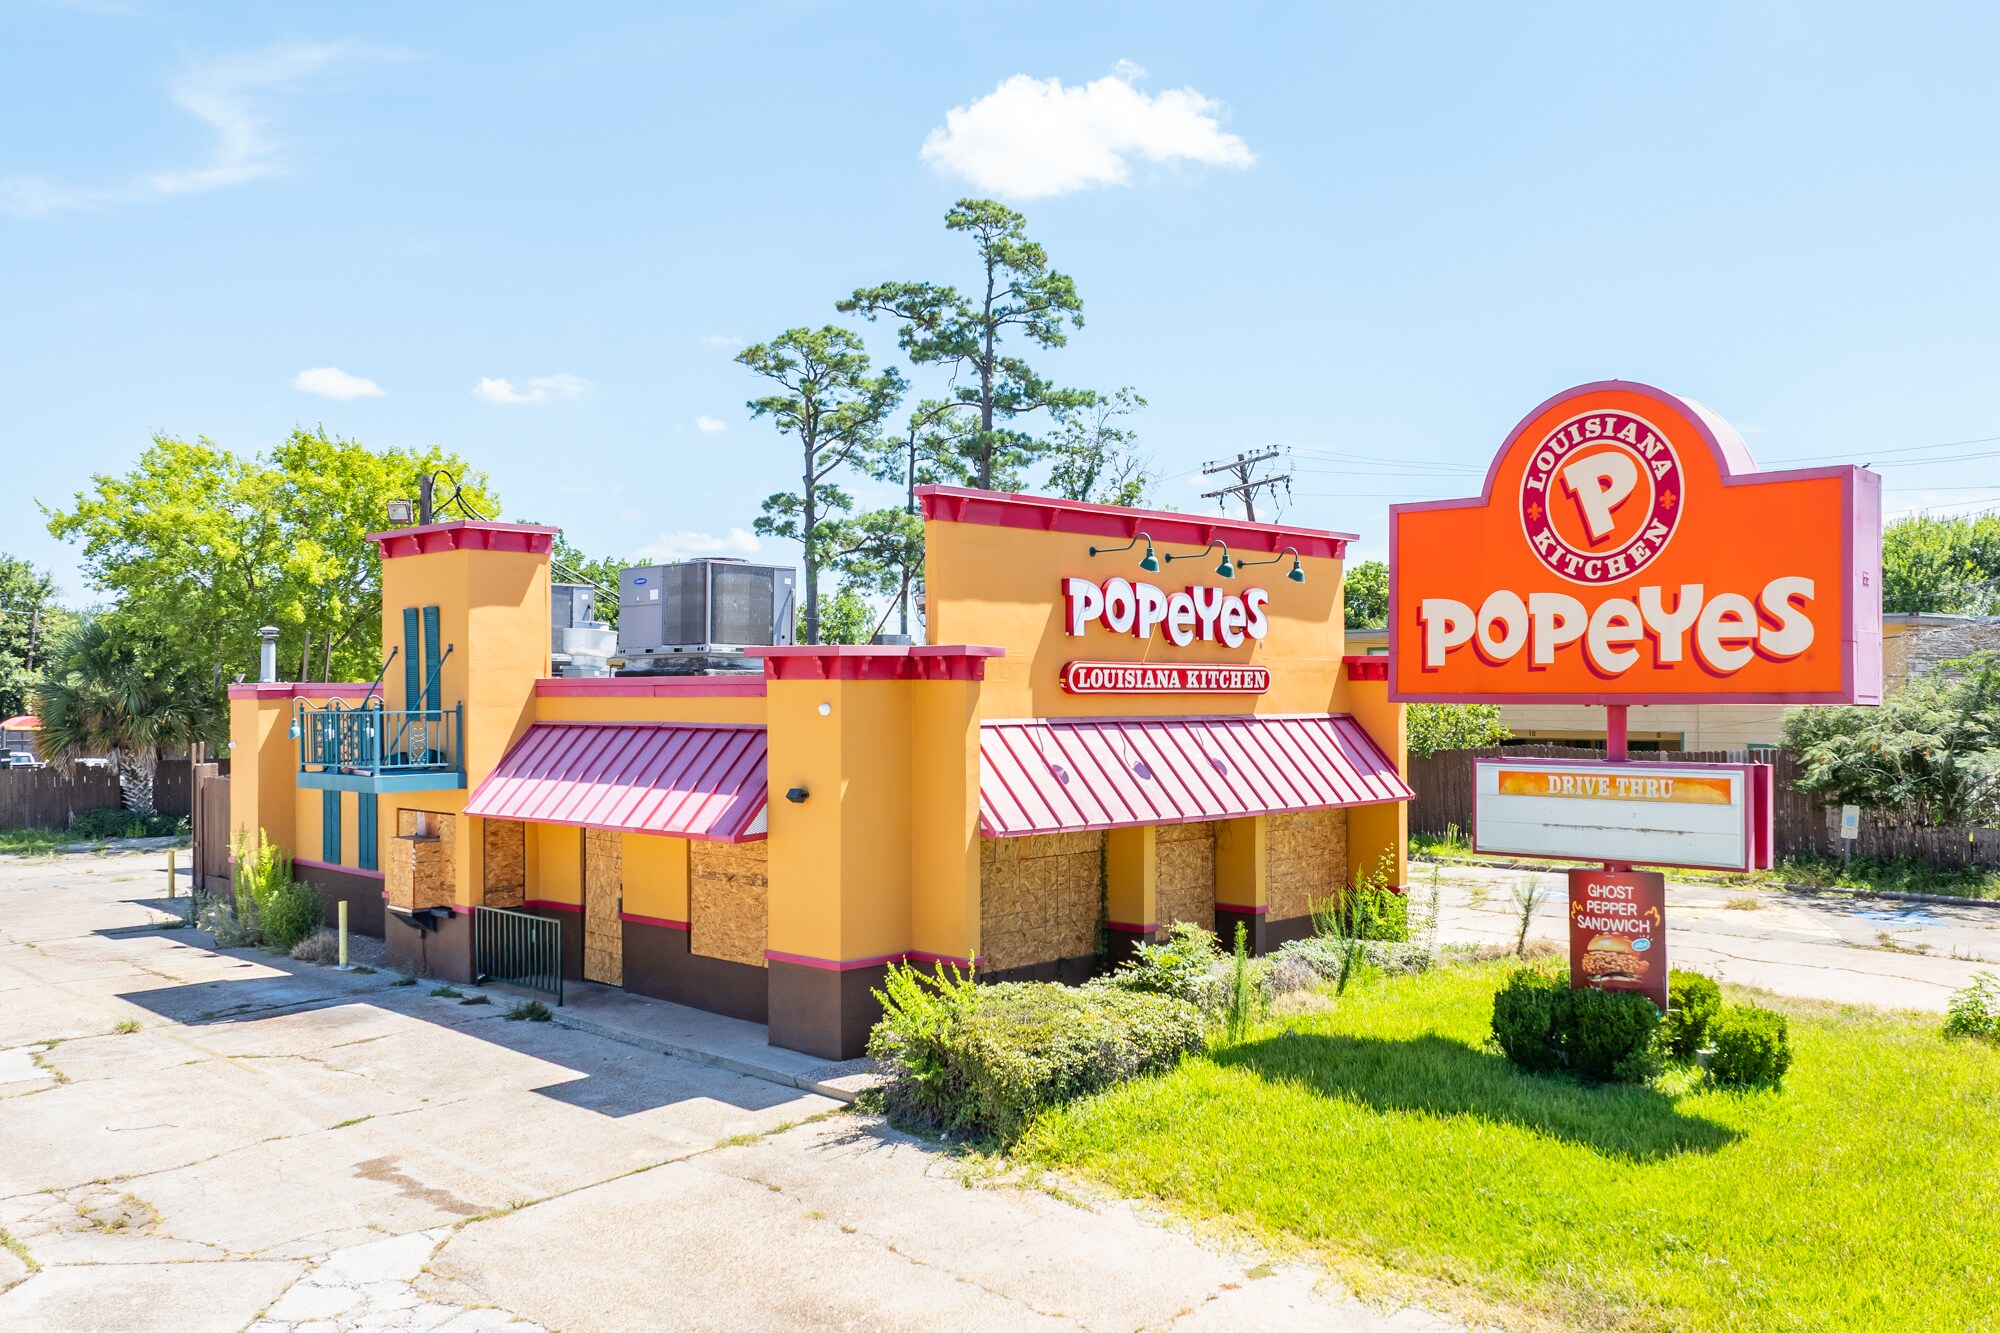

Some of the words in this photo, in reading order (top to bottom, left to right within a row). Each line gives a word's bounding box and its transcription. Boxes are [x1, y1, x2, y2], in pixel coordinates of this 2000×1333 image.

[1527, 417, 1673, 492] LOUISIANA
[1561, 451, 1638, 542] P
[1532, 518, 1669, 579] KITCHEN
[1077, 669, 1181, 689] LOUISIANA
[1186, 670, 1266, 689] KITCHEN
[1547, 775, 1609, 796] DRIVE
[1616, 777, 1673, 798] THRU
[1587, 883, 1634, 899] GHOST
[1586, 900, 1637, 916] PEPPER
[1577, 914, 1650, 933] SANDWICH
